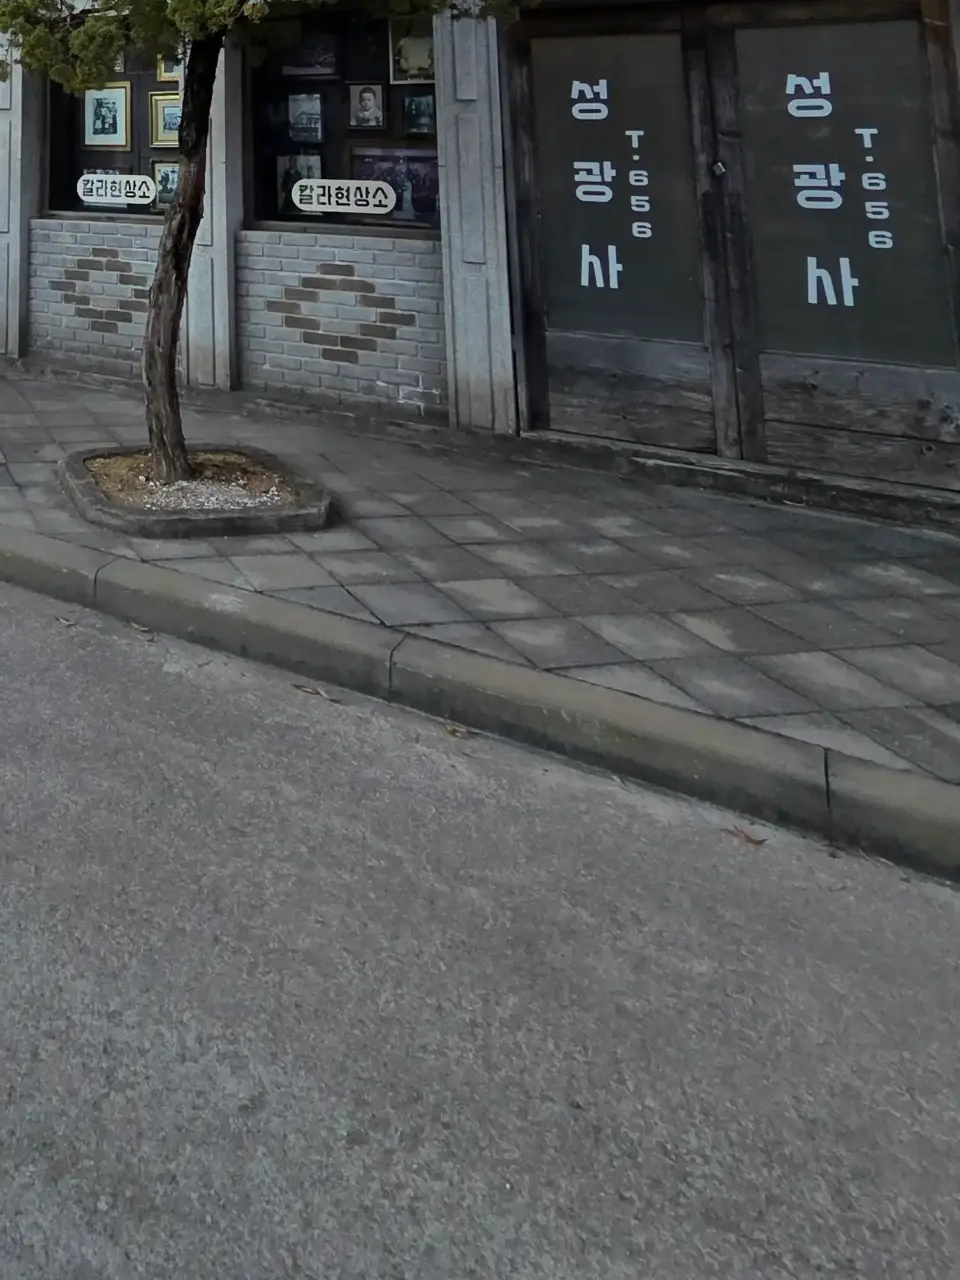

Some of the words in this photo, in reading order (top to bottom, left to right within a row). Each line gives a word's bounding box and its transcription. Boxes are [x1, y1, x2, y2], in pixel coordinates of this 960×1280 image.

[82, 179, 151, 199] 칼라현상소
[298, 184, 389, 208] 칼라현상소
[570, 78, 623, 289] 성광사
[785, 71, 859, 307] 성광사
